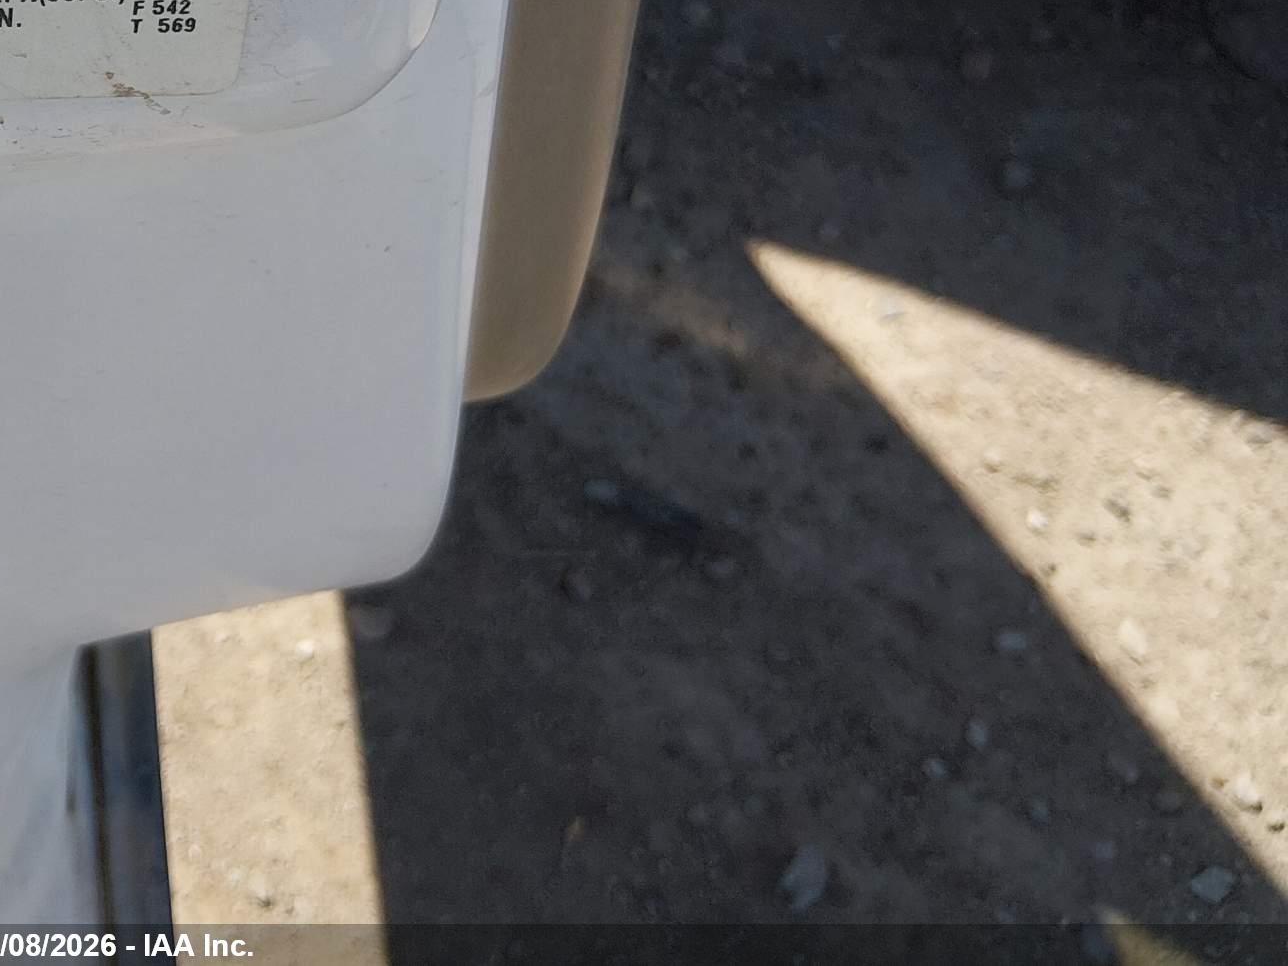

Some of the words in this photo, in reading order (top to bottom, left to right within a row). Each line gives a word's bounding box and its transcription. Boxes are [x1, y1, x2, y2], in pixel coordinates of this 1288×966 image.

[132, 0, 146, 15] F
[152, 0, 191, 15] 542
[131, 18, 143, 33] T
[157, 17, 196, 33] 569
